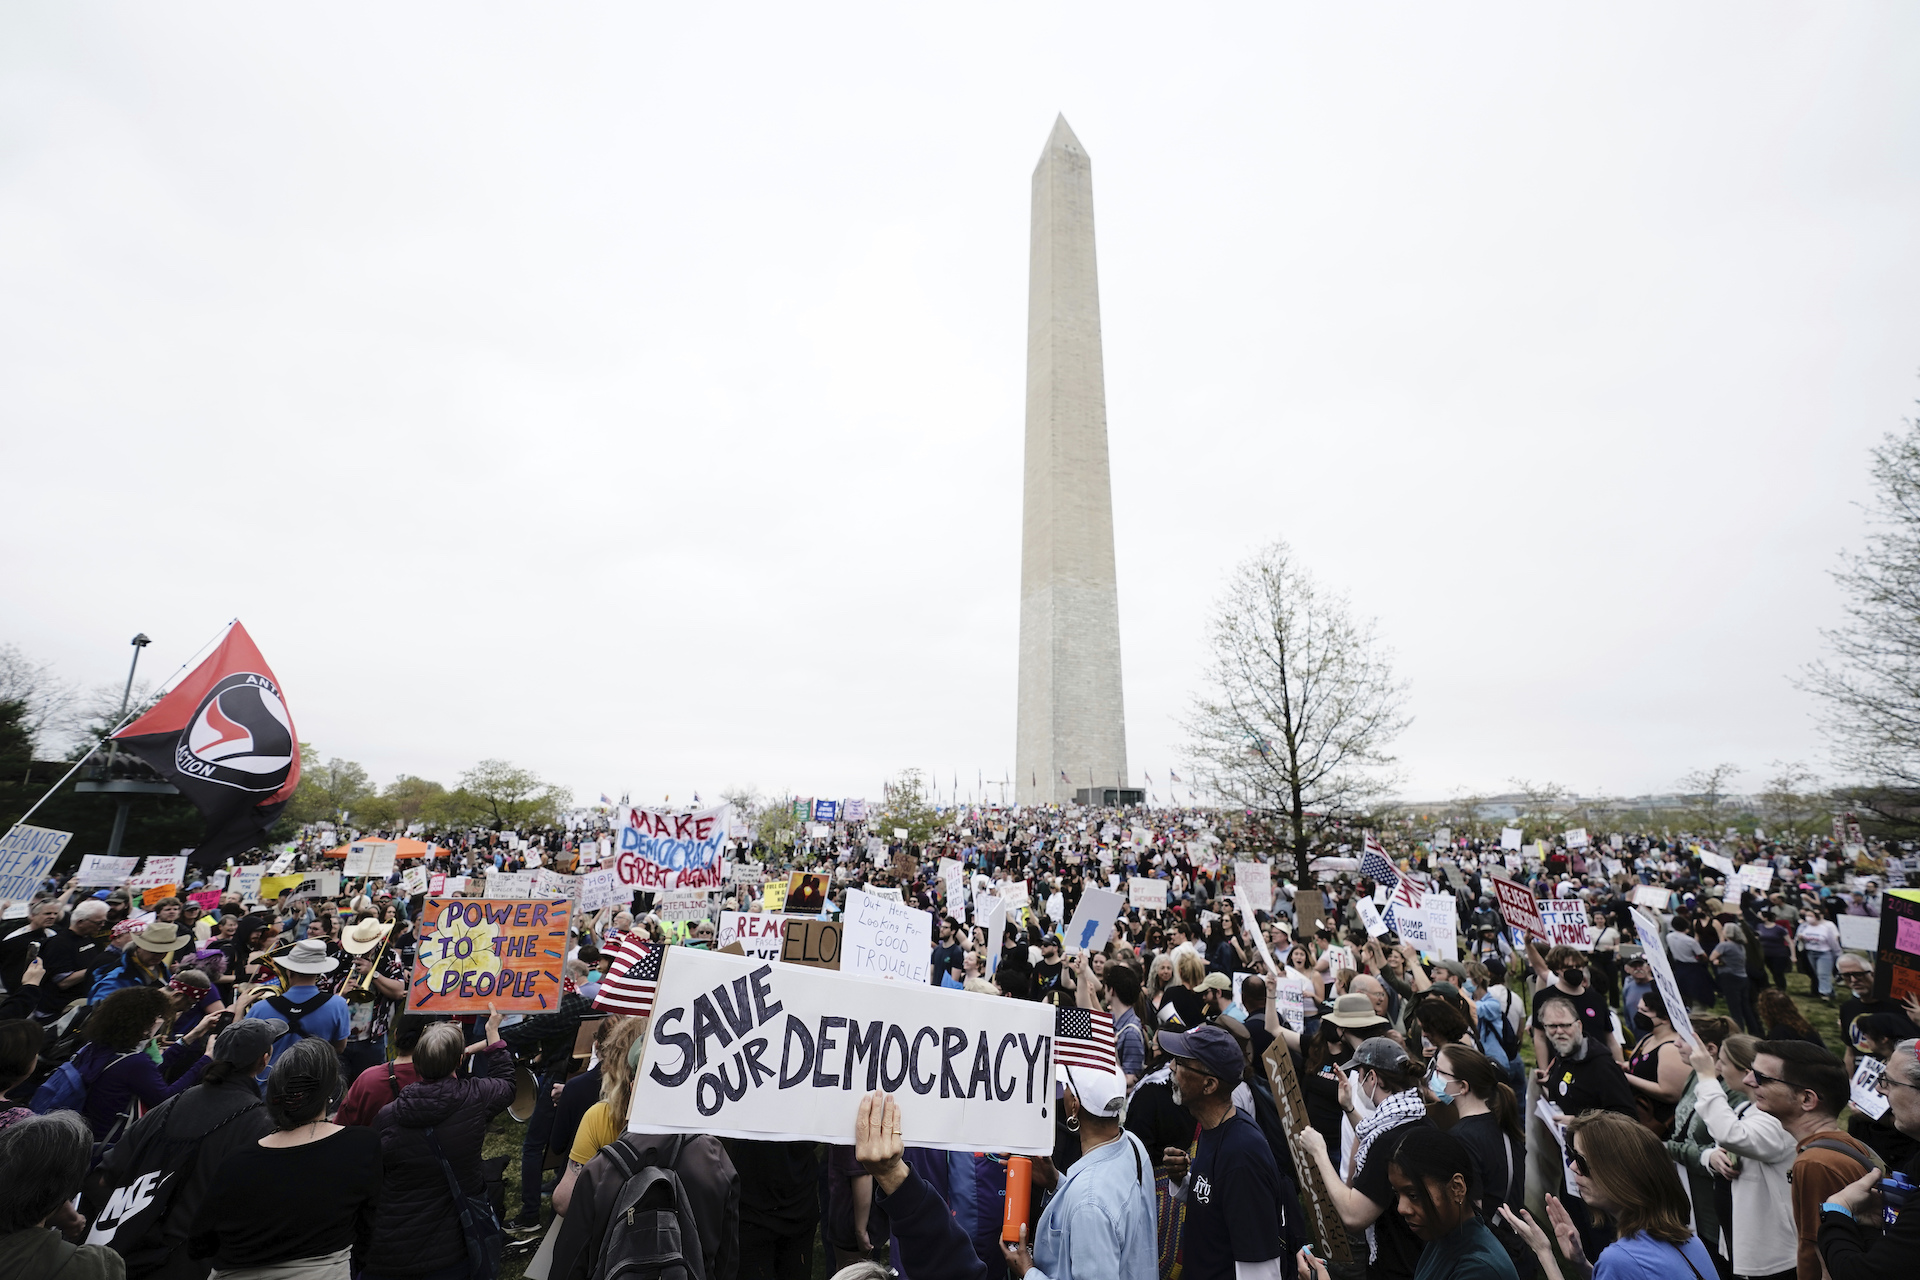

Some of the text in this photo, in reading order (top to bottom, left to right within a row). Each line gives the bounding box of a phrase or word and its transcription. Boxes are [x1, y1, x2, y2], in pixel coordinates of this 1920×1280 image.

[178, 744, 217, 778] ACTION
[630, 808, 715, 840] MAKE
[2, 826, 68, 855] HANDS
[621, 827, 724, 872] DEMOCRACY
[21, 854, 54, 878] MY
[617, 852, 674, 889] GREAT
[676, 855, 722, 889] AGAIN
[663, 900, 707, 911] STEALING
[863, 896, 882, 910] Out
[888, 902, 909, 920] Here
[1424, 898, 1455, 912] RESPECT
[1497, 882, 1534, 914] REJECT
[1538, 900, 1581, 912] OT RIGHT
[1888, 897, 1915, 916] 2016
[445, 901, 549, 928] POWER
[663, 909, 706, 920] FROM YOU
[858, 909, 922, 936] Looking For
[1401, 918, 1423, 930] DUMP
[1429, 912, 1448, 925] FREE
[783, 921, 843, 963] ELO
[874, 930, 909, 954] GOOD
[1430, 926, 1453, 940] PEECH
[1551, 924, 1591, 945] WRONG
[438, 936, 474, 960] TO
[492, 935, 540, 958] THE
[1880, 949, 1911, 968] 2025
[856, 944, 930, 983] TROUBLE!
[440, 969, 540, 998] PEOPLE
[649, 963, 784, 1088] SAVE
[696, 1013, 1052, 1120] OUR DEMOCRACY!
[1265, 1057, 1297, 1127] ARMS
[1280, 1116, 1310, 1193] NOW
